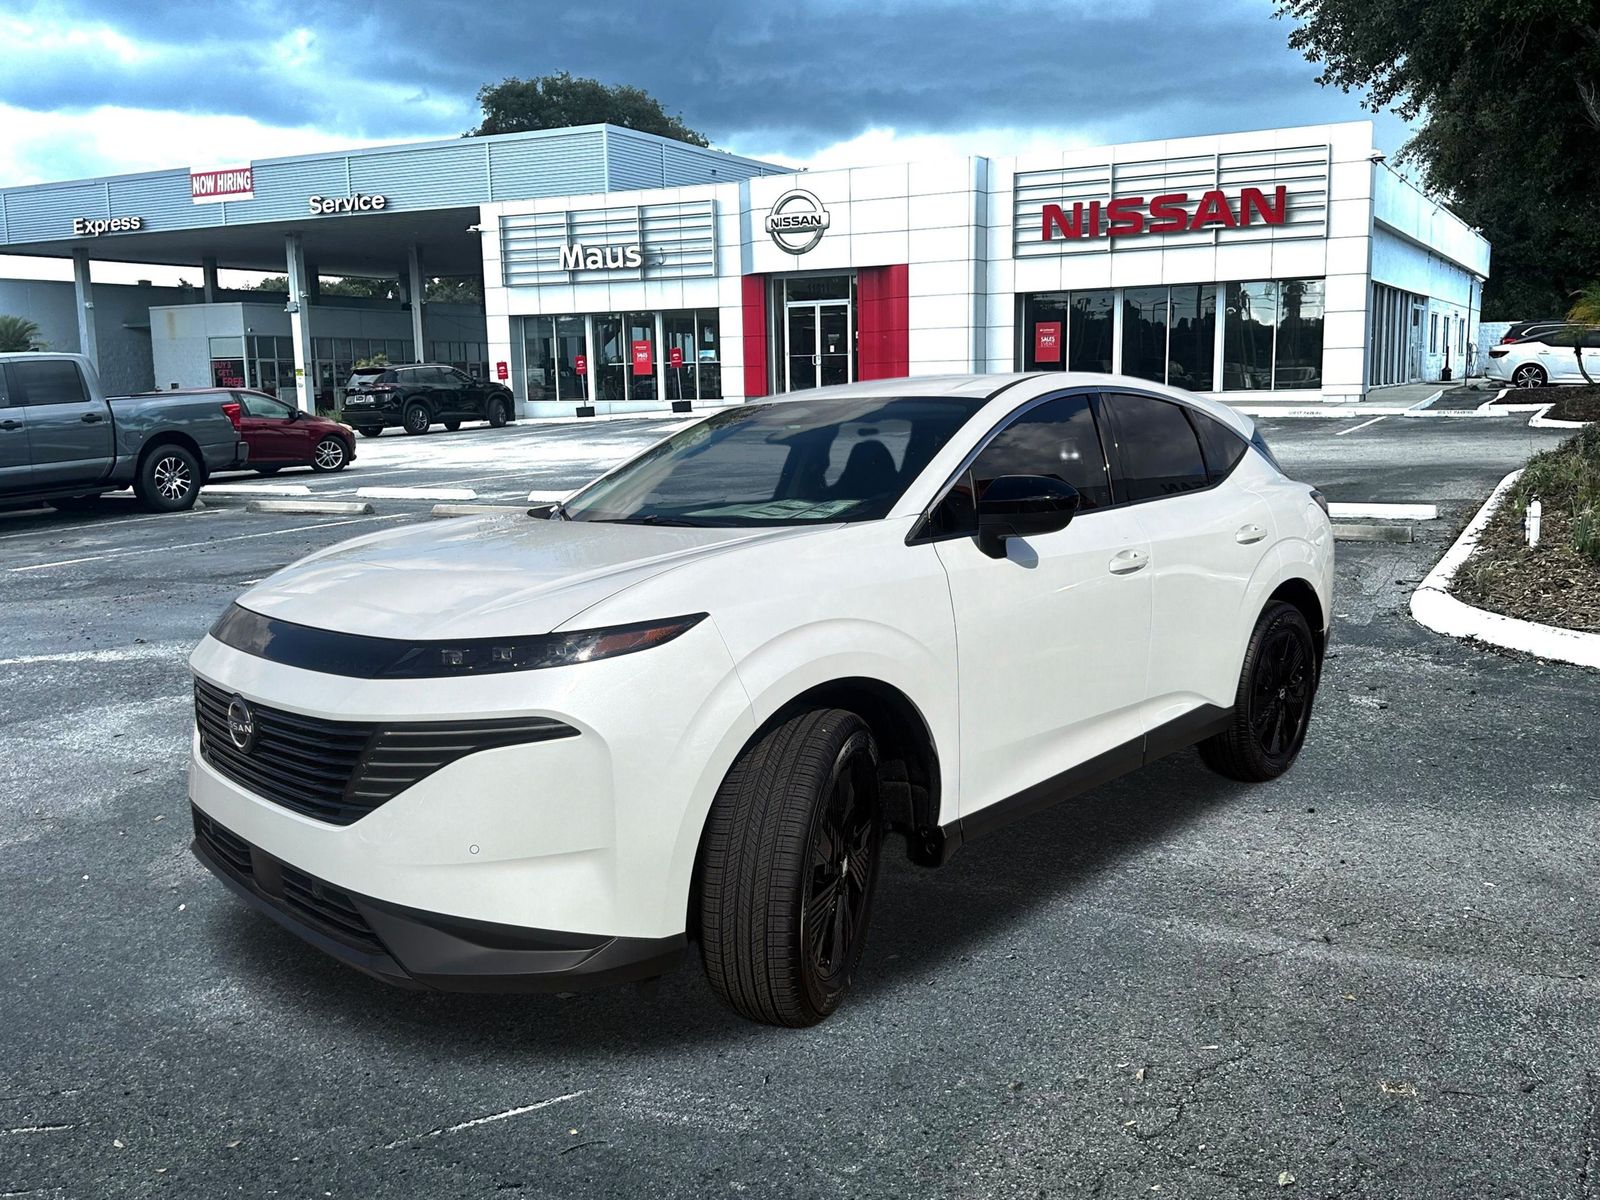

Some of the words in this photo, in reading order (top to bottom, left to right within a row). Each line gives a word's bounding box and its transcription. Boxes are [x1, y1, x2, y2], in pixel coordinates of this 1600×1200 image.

[192, 174, 215, 195] NOW
[217, 171, 251, 192] HIRING
[309, 193, 385, 214] Service
[1042, 185, 1287, 241] NISSAN
[73, 217, 141, 236] Express
[771, 215, 821, 228] NISSAN
[560, 243, 642, 270] Maus
[223, 377, 243, 386] FREE
